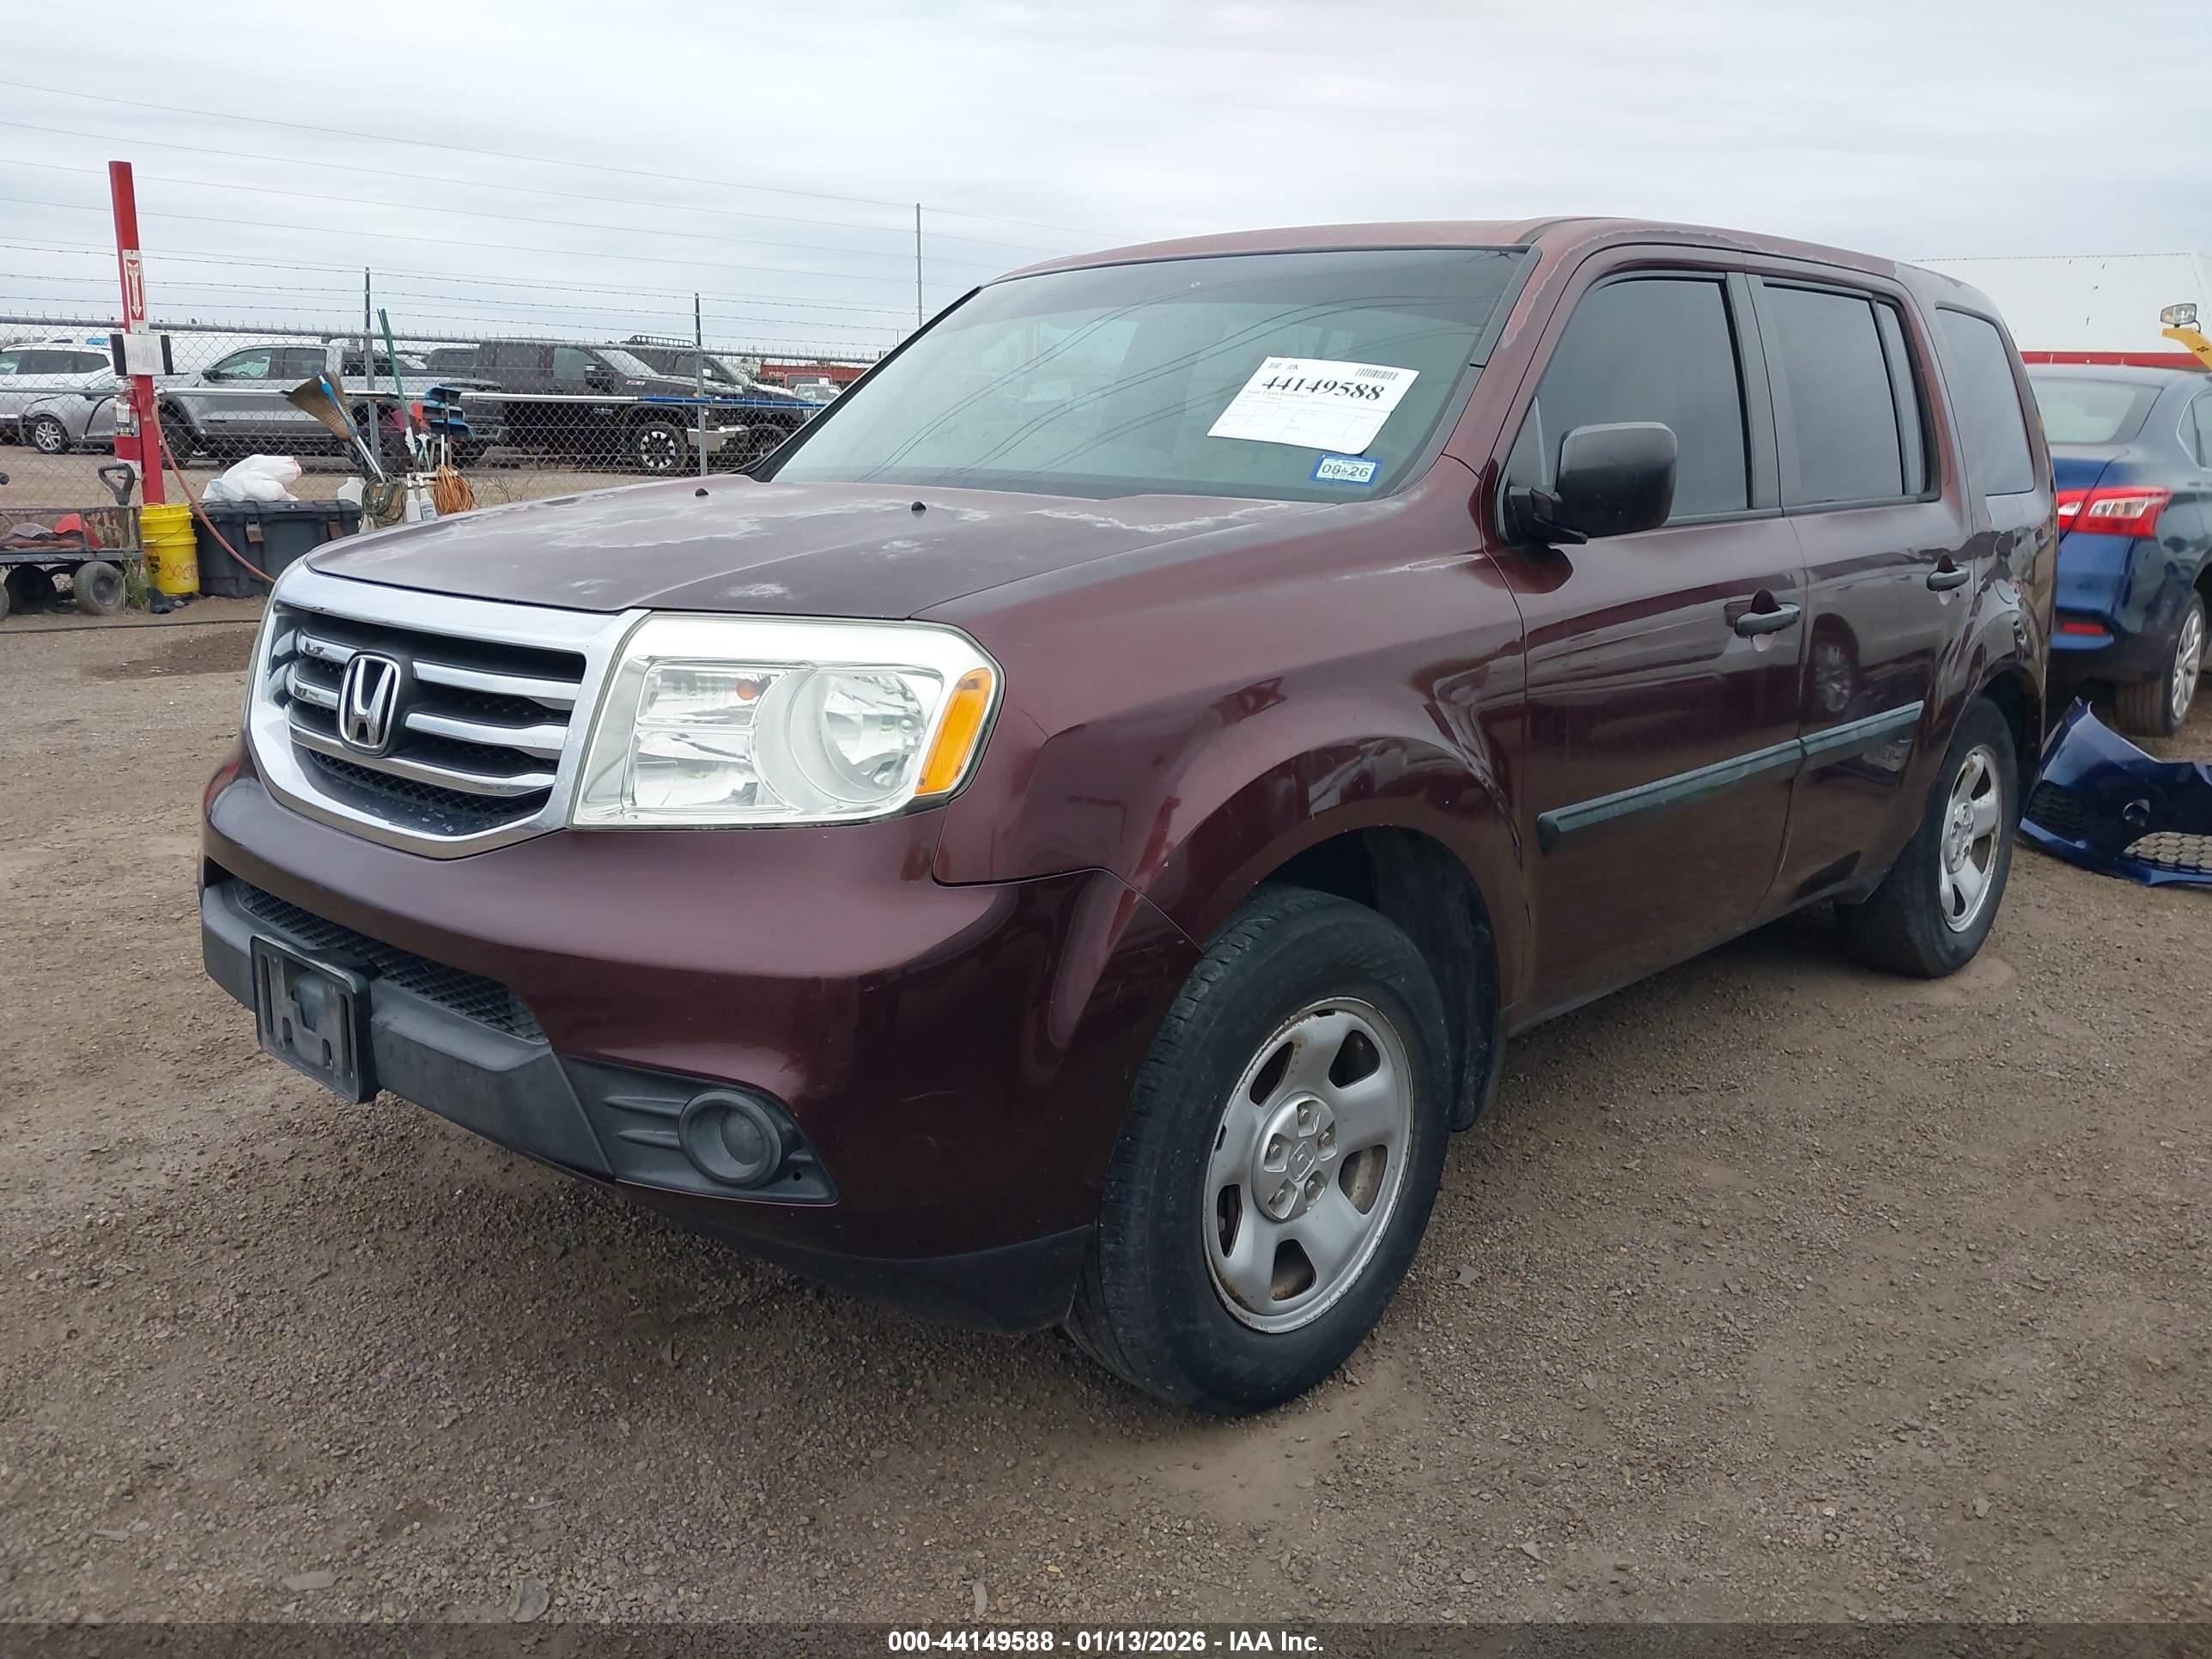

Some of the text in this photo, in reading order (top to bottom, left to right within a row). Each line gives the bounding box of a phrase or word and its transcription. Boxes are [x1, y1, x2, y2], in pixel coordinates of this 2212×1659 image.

[1262, 375, 1385, 401] 44149588
[1322, 464, 1370, 477] 08 26
